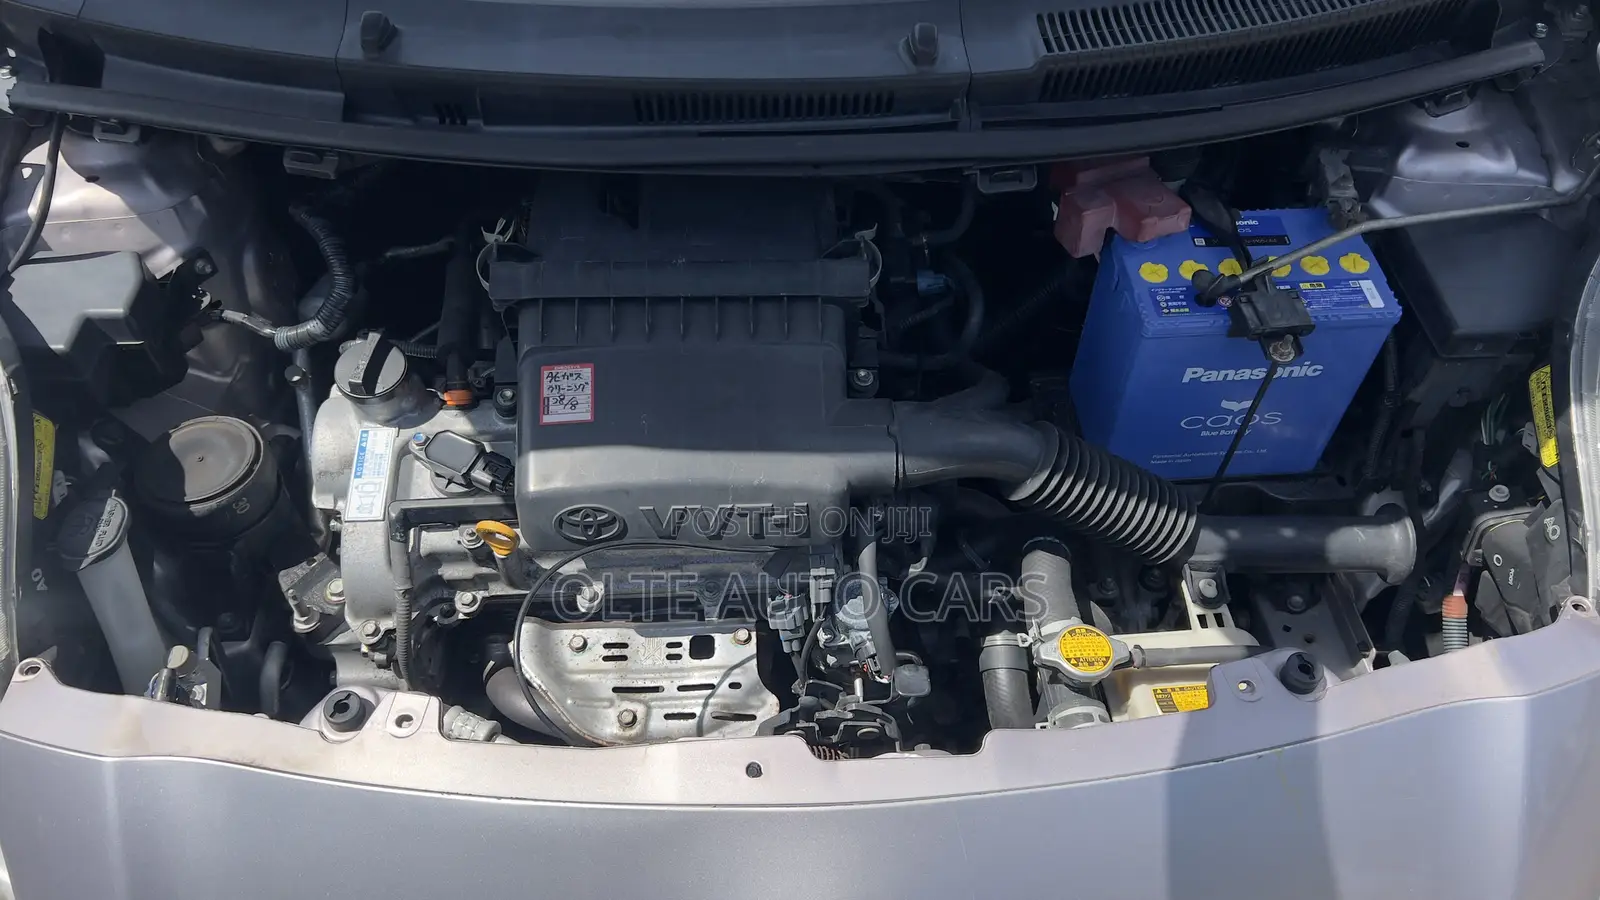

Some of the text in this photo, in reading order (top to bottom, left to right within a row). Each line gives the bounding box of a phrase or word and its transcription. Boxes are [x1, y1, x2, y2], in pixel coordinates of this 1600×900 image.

[1180, 409, 1283, 431] caos
[1200, 427, 1252, 437] Blue Batty
[355, 451, 366, 477] NOTICE
